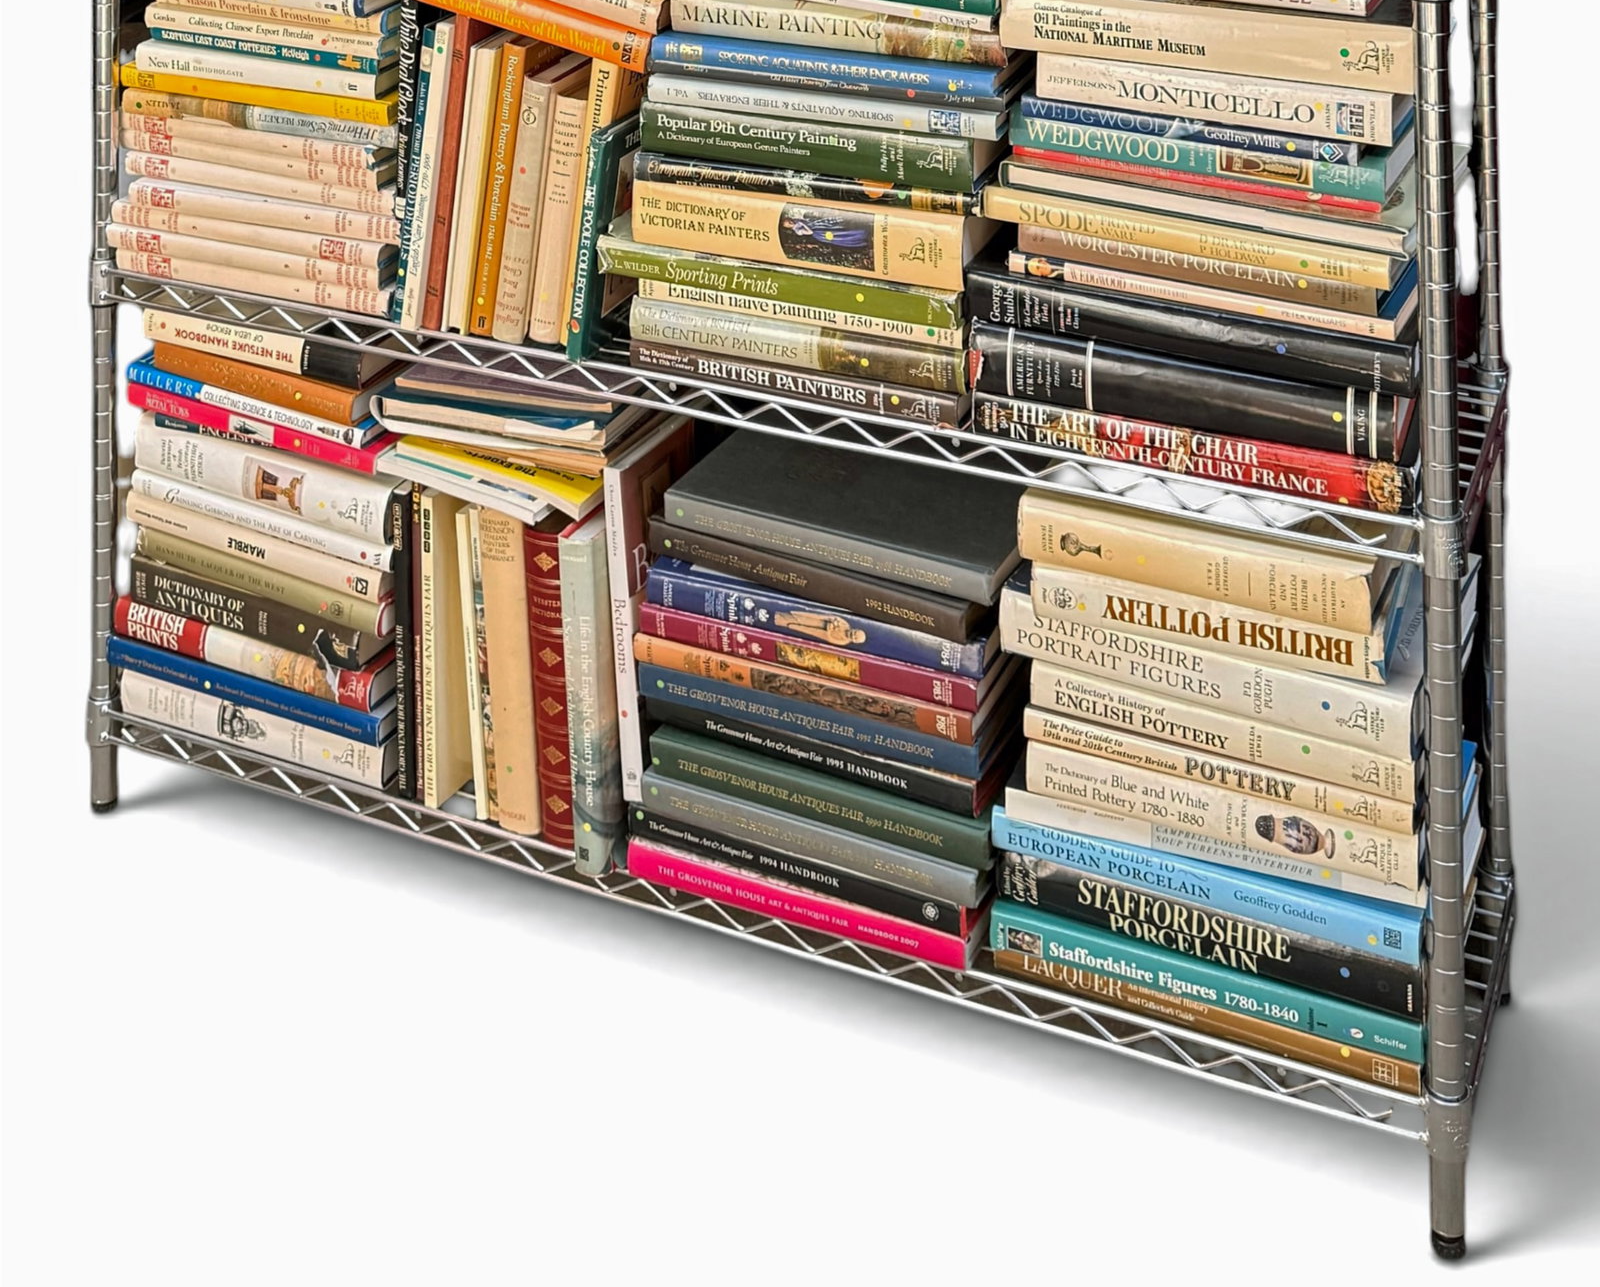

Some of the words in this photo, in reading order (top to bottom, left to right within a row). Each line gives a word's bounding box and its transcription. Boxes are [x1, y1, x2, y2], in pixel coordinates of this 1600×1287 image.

[188, 16, 222, 30] Collecting
[226, 21, 252, 33] Chinese
[256, 25, 280, 36] Export
[282, 28, 314, 40] Porcelain
[682, 4, 769, 29] MARINE
[778, 12, 883, 40] PAINTING
[1034, 25, 1088, 44] NATIONAL
[1093, 31, 1153, 51] MARITIME
[1158, 39, 1205, 57] MUSEUM
[148, 56, 169, 69] New
[171, 58, 190, 71] Hall
[1115, 80, 1315, 124] MONTICELLO
[657, 114, 707, 131] Popular
[709, 119, 736, 133] 19th
[739, 123, 794, 143] Century
[799, 127, 857, 152] Painting
[1025, 120, 1180, 163] WEDGWOOD
[665, 261, 727, 290] Sporting
[731, 271, 778, 295] Prints
[129, 366, 193, 396] MILLER'S
[698, 359, 770, 387] BRITISH
[776, 374, 866, 406] PAINTERS
[1009, 401, 1050, 425] THE
[1057, 410, 1098, 438] ART
[1106, 419, 1133, 439] OF
[1143, 424, 1184, 449] THE
[1191, 433, 1258, 465] CHAIR
[1010, 423, 1029, 441] IN
[1035, 428, 1245, 483] EIGHTEENTH-CENTURY
[1251, 467, 1328, 496] FRANCE
[228, 538, 266, 560] MARBLE
[154, 575, 225, 604] DICTIONARY
[228, 595, 244, 612] OF
[156, 593, 244, 630] ANTIQUES
[614, 598, 627, 674] Bedrooms
[1102, 594, 1229, 643] POTTERY
[1017, 629, 1121, 670] PORTRAIT
[1130, 661, 1221, 700] FIGURES
[1034, 614, 1203, 673] STAFFORDSHIRE
[1238, 623, 1355, 666] BRITISH
[678, 759, 698, 772] THE
[699, 765, 756, 790] GROSVENOR
[758, 781, 789, 800] HOUSE
[791, 790, 839, 813] ANTIQUES
[841, 805, 864, 821] FAIR
[866, 813, 883, 827] 1990
[884, 819, 943, 846] HANDBOOK
[1044, 776, 1089, 801] Printed
[1092, 788, 1136, 812] Pottery
[1110, 773, 1137, 793] Blue
[1142, 783, 1165, 799] and
[1170, 787, 1210, 811] White
[1007, 832, 1101, 870] EUROPEAN
[1108, 862, 1211, 900] PORCELAIN
[858, 924, 898, 942] HANDBOOK
[900, 937, 919, 949] 2007
[1077, 878, 1291, 963] STAFFORDSHIRE
[1108, 912, 1259, 974] PORCELAIN
[1022, 954, 1123, 999] LACQUER
[1048, 942, 1154, 984] Staffordshire
[1158, 972, 1217, 1001] Figures
[1224, 992, 1299, 1023] 1780-1840
